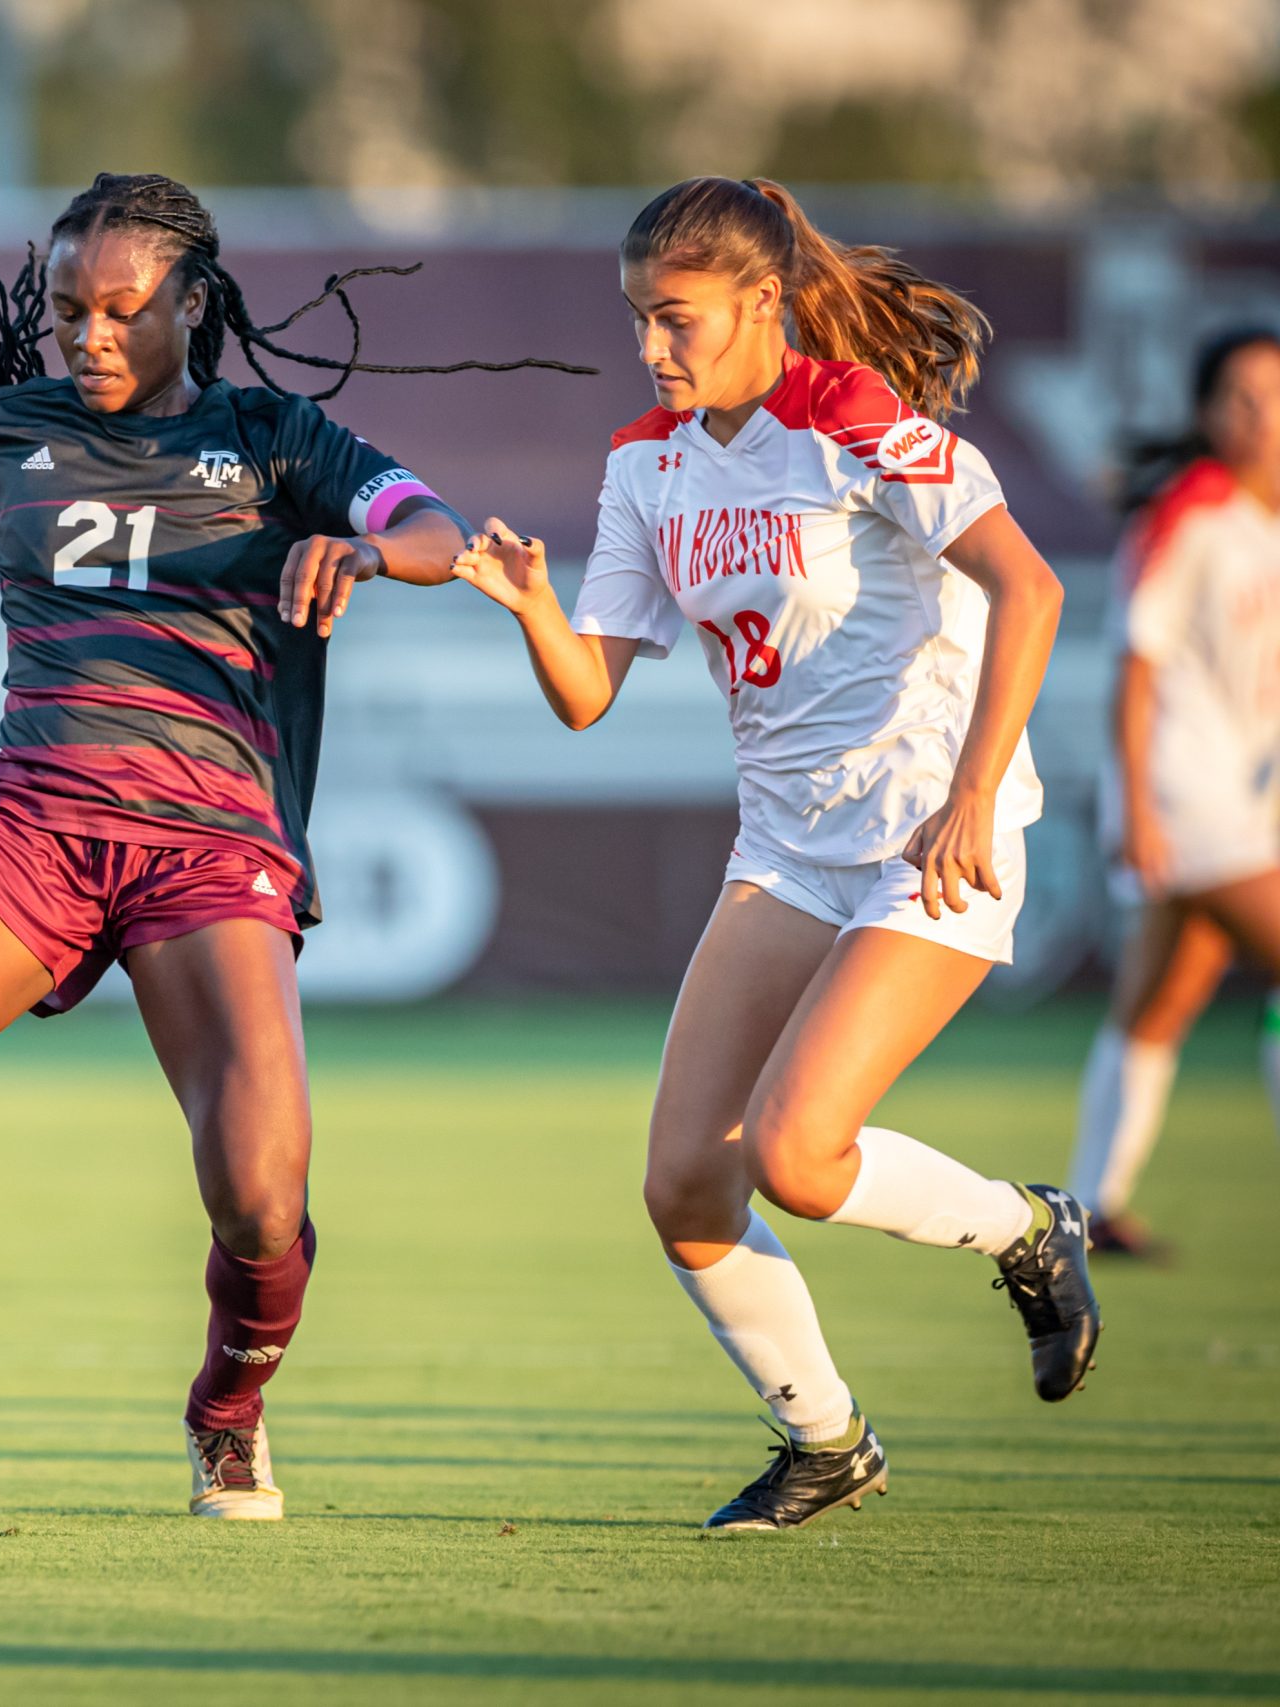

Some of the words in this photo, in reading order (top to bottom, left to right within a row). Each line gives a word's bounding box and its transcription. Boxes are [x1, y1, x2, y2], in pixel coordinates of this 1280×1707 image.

[21, 462, 55, 470] adidas
[885, 425, 933, 460] WAC
[53, 500, 157, 591] 21
[689, 507, 808, 588] HOUSTON
[697, 609, 782, 695] 18
